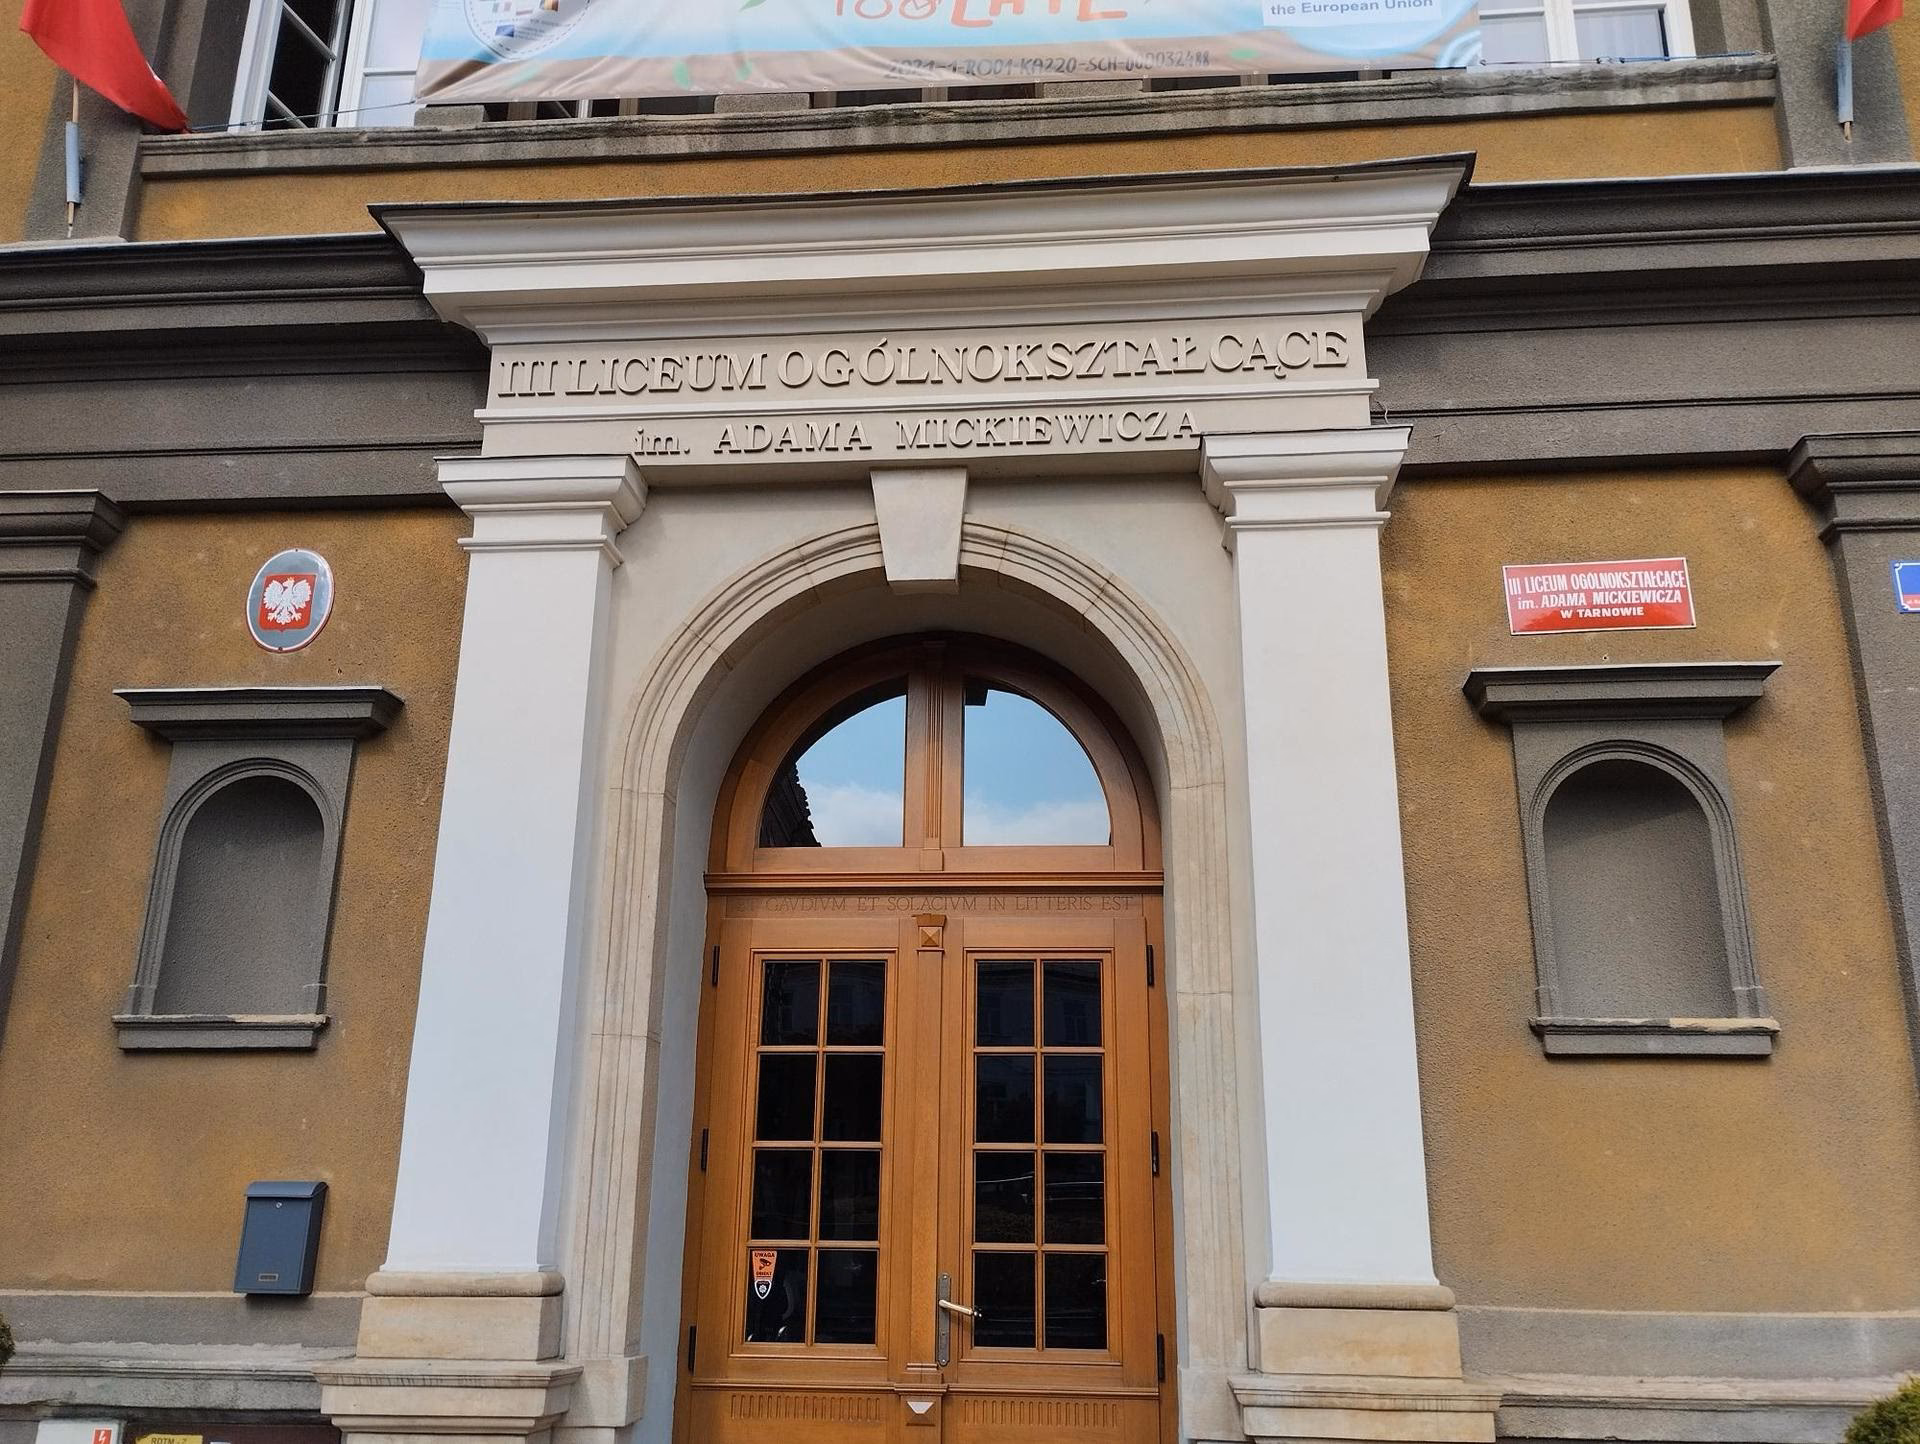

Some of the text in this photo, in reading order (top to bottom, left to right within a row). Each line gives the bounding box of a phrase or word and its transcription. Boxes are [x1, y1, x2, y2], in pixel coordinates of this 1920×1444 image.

[1271, 5, 1296, 15] the
[1302, 1, 1379, 14] European
[498, 331, 1349, 397] III LICEUM OGÓLNOKSZTAŁCĄCE
[634, 409, 1200, 456] im. ADAMA MICKIEWICZA
[1508, 577, 1521, 595] III
[1524, 574, 1568, 594] LICEUM
[1518, 589, 1682, 610] im. ADAMA MICKIEWICZA
[1560, 606, 1644, 618] W TARNOWIE
[766, 896, 846, 912] GAVDIVM
[858, 896, 880, 912] ET
[888, 896, 977, 912] SOLACIVM
[988, 896, 1006, 911] IN
[1016, 896, 1093, 911] LITTERIS
[1102, 896, 1134, 911] EST
